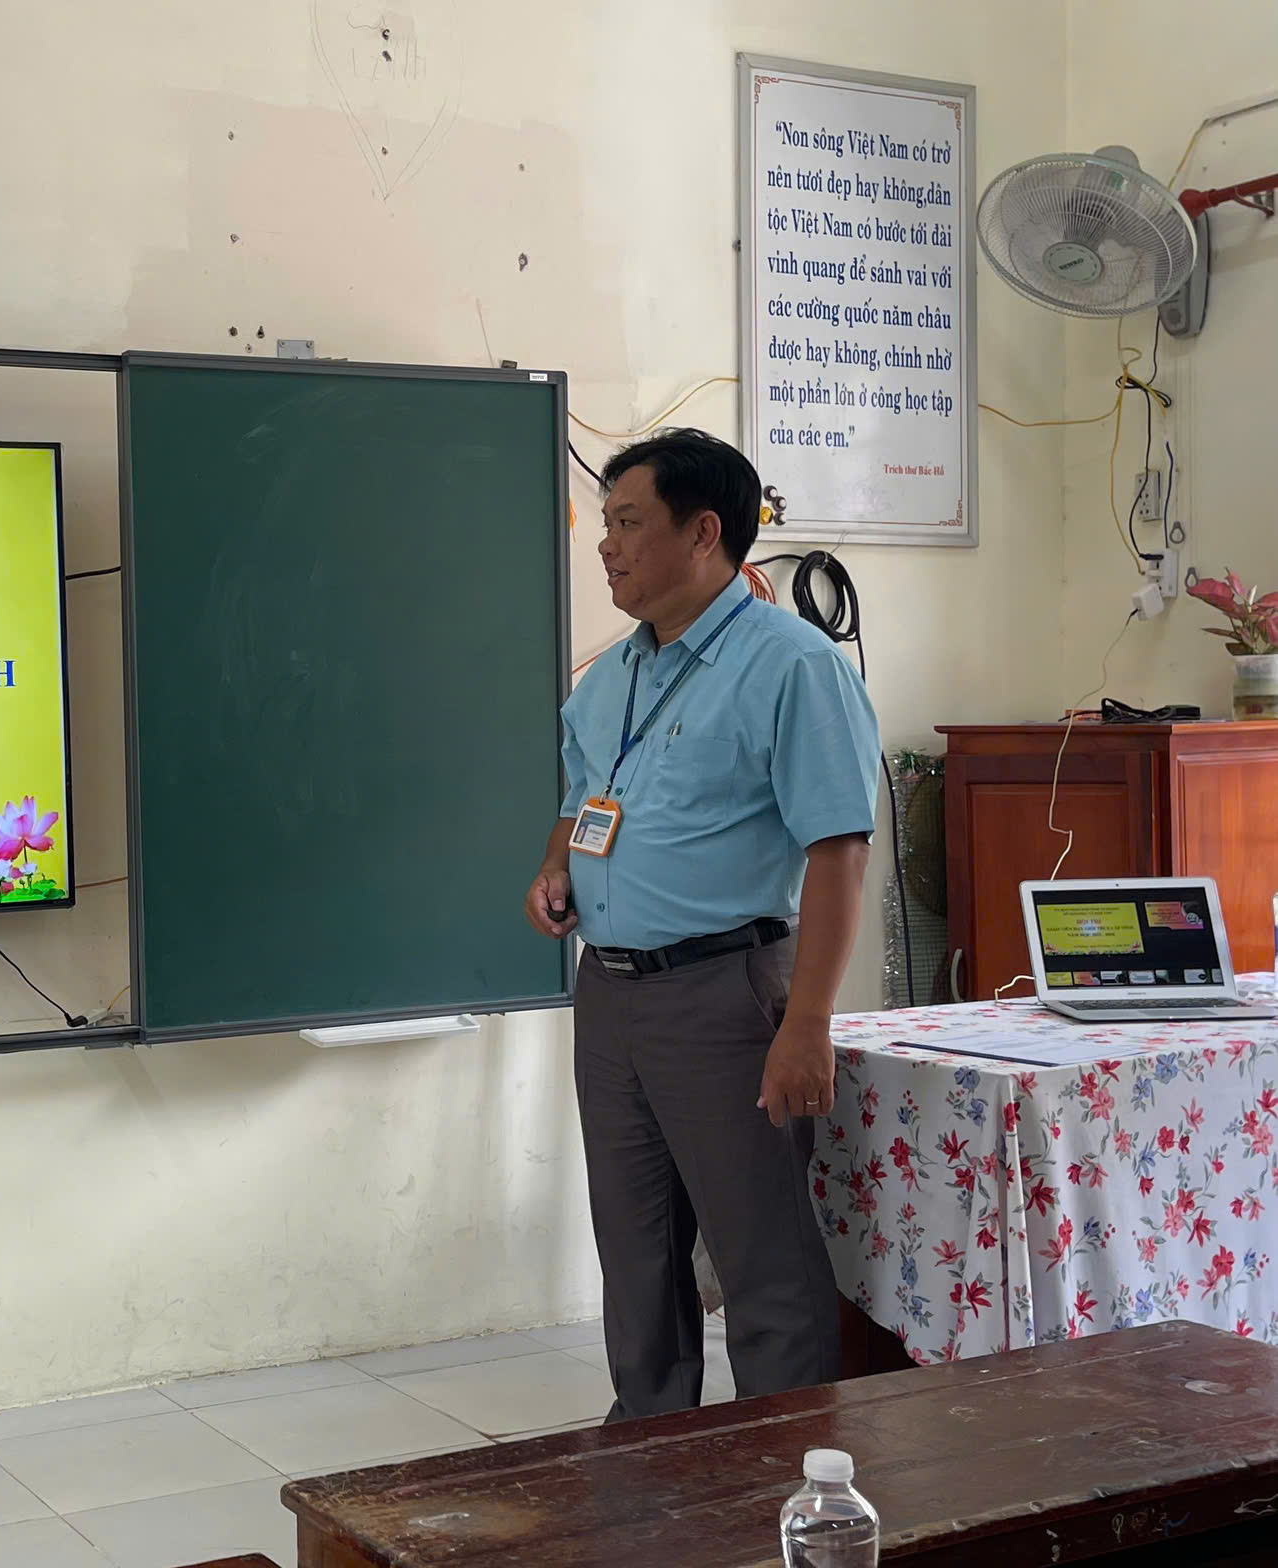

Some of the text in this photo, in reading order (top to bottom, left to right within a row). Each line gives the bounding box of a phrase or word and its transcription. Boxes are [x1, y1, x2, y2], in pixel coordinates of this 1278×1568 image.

[813, 127, 844, 158] sông
[848, 130, 875, 160] Việt
[879, 134, 908, 159] Nam
[913, 141, 927, 162] có
[932, 140, 951, 164] trở
[767, 165, 792, 188] nên
[797, 168, 822, 192] tươi
[827, 170, 851, 201] đẹp
[856, 173, 879, 204] hay
[768, 208, 951, 247] tộc Việt Nam có bước tới đài
[768, 250, 951, 288] vinh quang để sánh vai với
[768, 293, 951, 329] các cường quốc năm châu
[769, 335, 952, 371] được hay không, chính nhờ
[770, 377, 952, 417] một phần lớn ở công học tập
[770, 420, 794, 445] của
[799, 423, 821, 446] các
